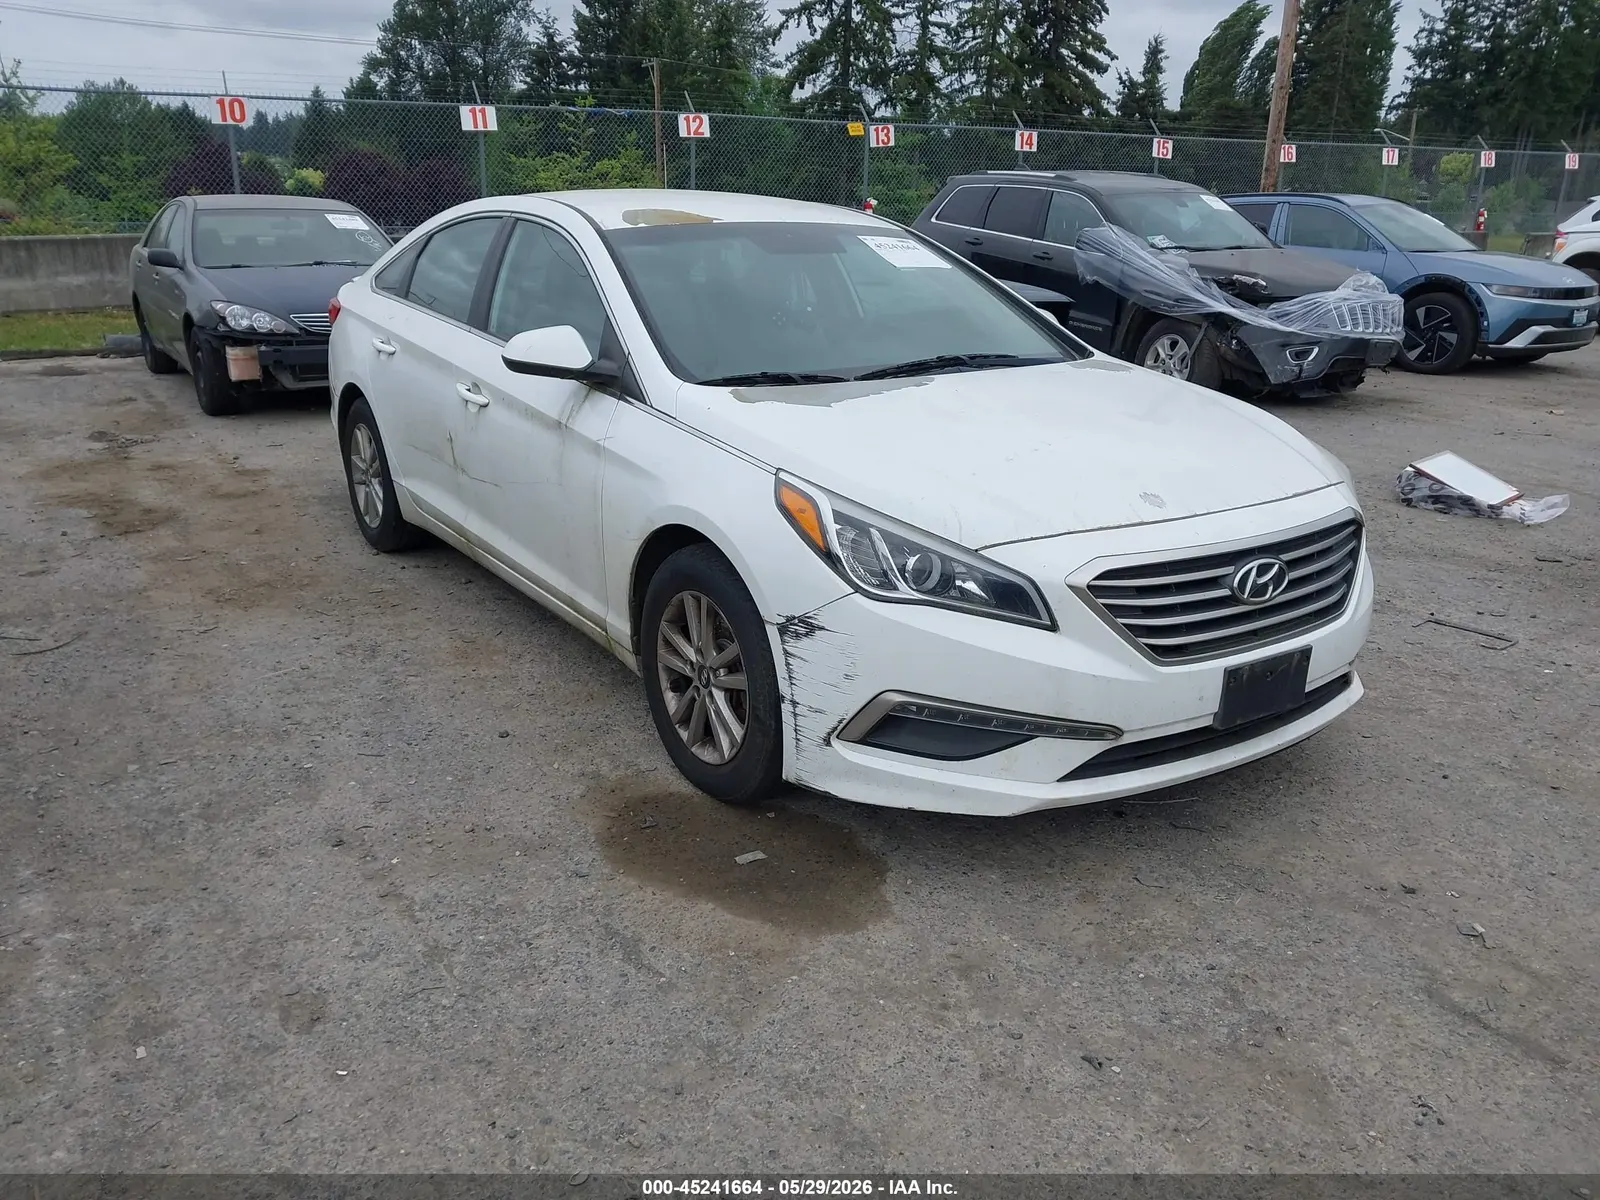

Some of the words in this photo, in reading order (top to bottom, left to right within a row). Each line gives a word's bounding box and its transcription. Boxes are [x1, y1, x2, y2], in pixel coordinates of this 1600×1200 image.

[216, 97, 247, 124] 10
[469, 107, 489, 129] 11
[683, 114, 705, 137] 12
[873, 125, 891, 146] 13
[1019, 132, 1034, 149] 14
[1157, 140, 1169, 158] 15
[1281, 145, 1293, 161] 16
[1386, 148, 1396, 164] 17
[1483, 151, 1494, 167] 18
[1567, 154, 1577, 169] 19
